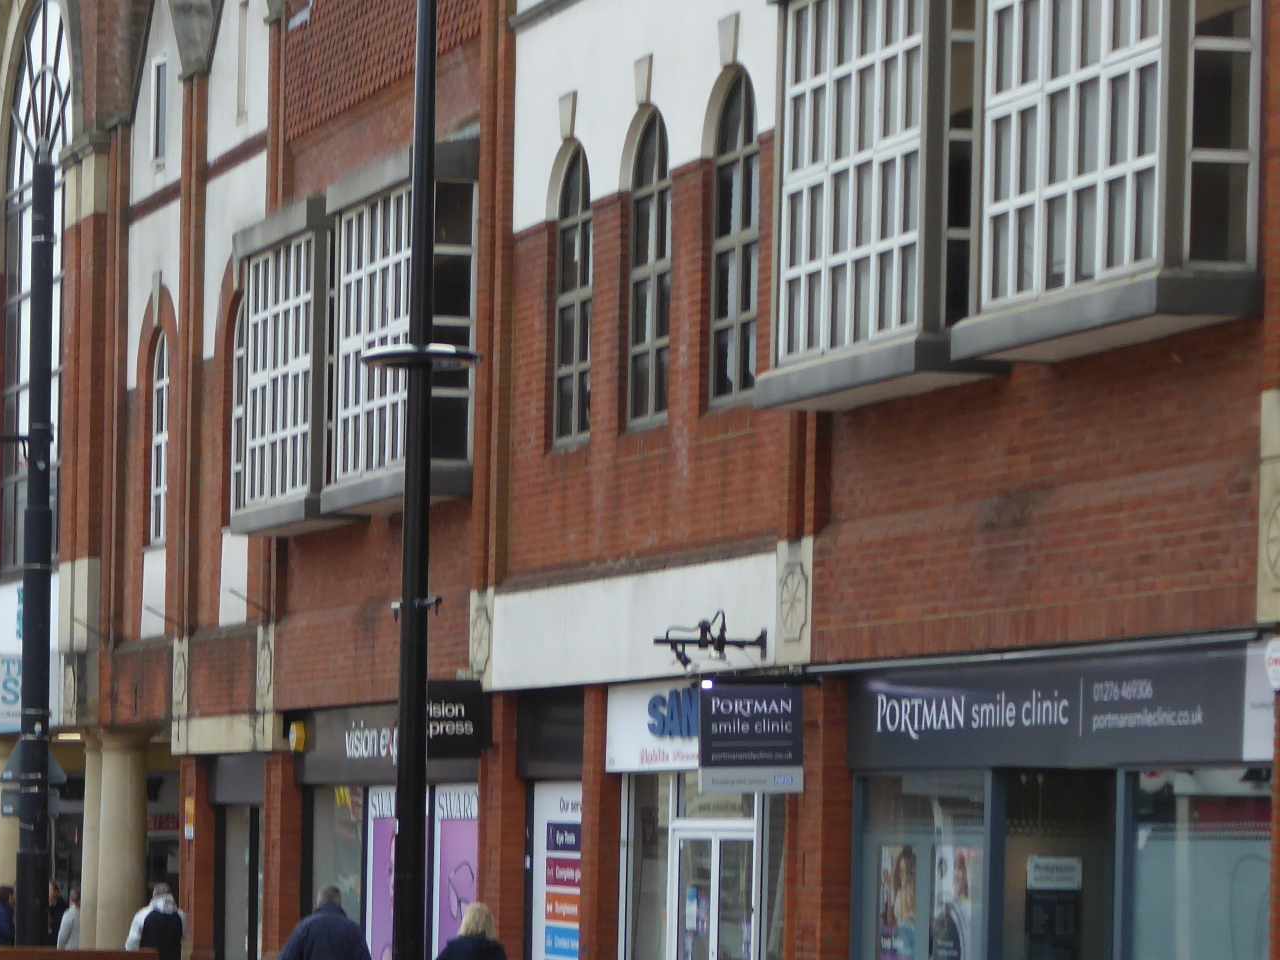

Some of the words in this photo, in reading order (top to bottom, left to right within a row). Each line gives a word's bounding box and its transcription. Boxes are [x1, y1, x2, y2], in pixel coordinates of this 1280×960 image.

[1, 678, 20, 706] S
[427, 700, 465, 718] ision
[712, 697, 792, 717] PORTMAN
[876, 693, 965, 740] PORTMAN
[971, 693, 1016, 728] smile
[1022, 690, 1069, 726] clinic
[429, 720, 474, 739] press
[712, 718, 750, 735] smile
[755, 718, 793, 735] clinic
[345, 720, 379, 759] vision
